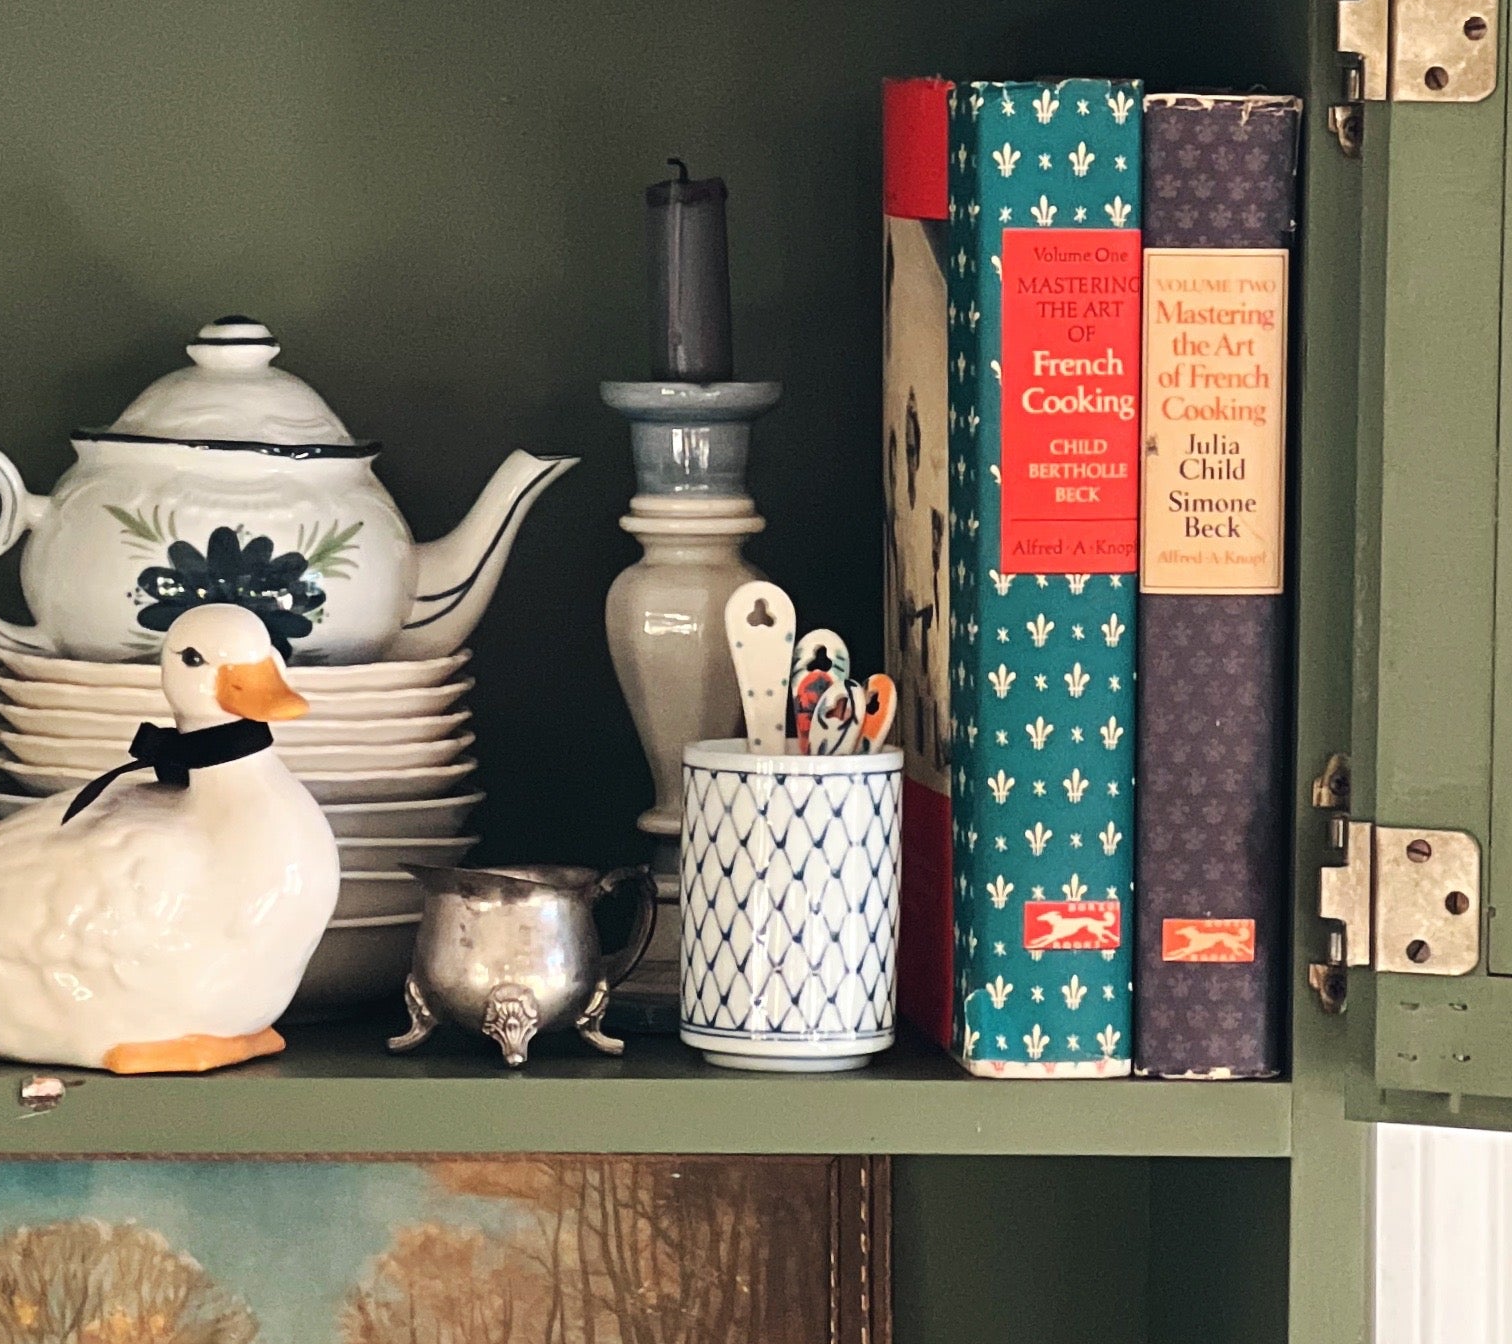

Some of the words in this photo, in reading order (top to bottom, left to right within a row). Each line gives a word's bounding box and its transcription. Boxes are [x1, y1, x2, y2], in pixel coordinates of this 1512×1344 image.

[1033, 246, 1091, 262] Volume
[1095, 247, 1128, 262] One
[1156, 279, 1231, 292] VOLUME
[1239, 279, 1276, 292] TWO
[1036, 301, 1077, 318] THE
[1083, 301, 1124, 317] ART
[1156, 300, 1274, 330] Mastering
[1068, 325, 1095, 342] OF
[1172, 332, 1210, 356] the
[1214, 333, 1254, 356] Art
[1033, 348, 1123, 375] French
[1158, 363, 1185, 388] of
[1190, 364, 1269, 388] French
[1022, 385, 1135, 421] Cooking
[1161, 396, 1266, 426] Cooking
[1050, 439, 1107, 454] CHILD
[1185, 433, 1240, 455] Julia
[1029, 463, 1128, 478] BERTHOLLE
[1179, 458, 1245, 480] Child
[1055, 487, 1100, 502] BECK
[1168, 490, 1257, 513] Simone
[1185, 516, 1240, 538] Beck
[1012, 539, 1062, 555] Alfred
